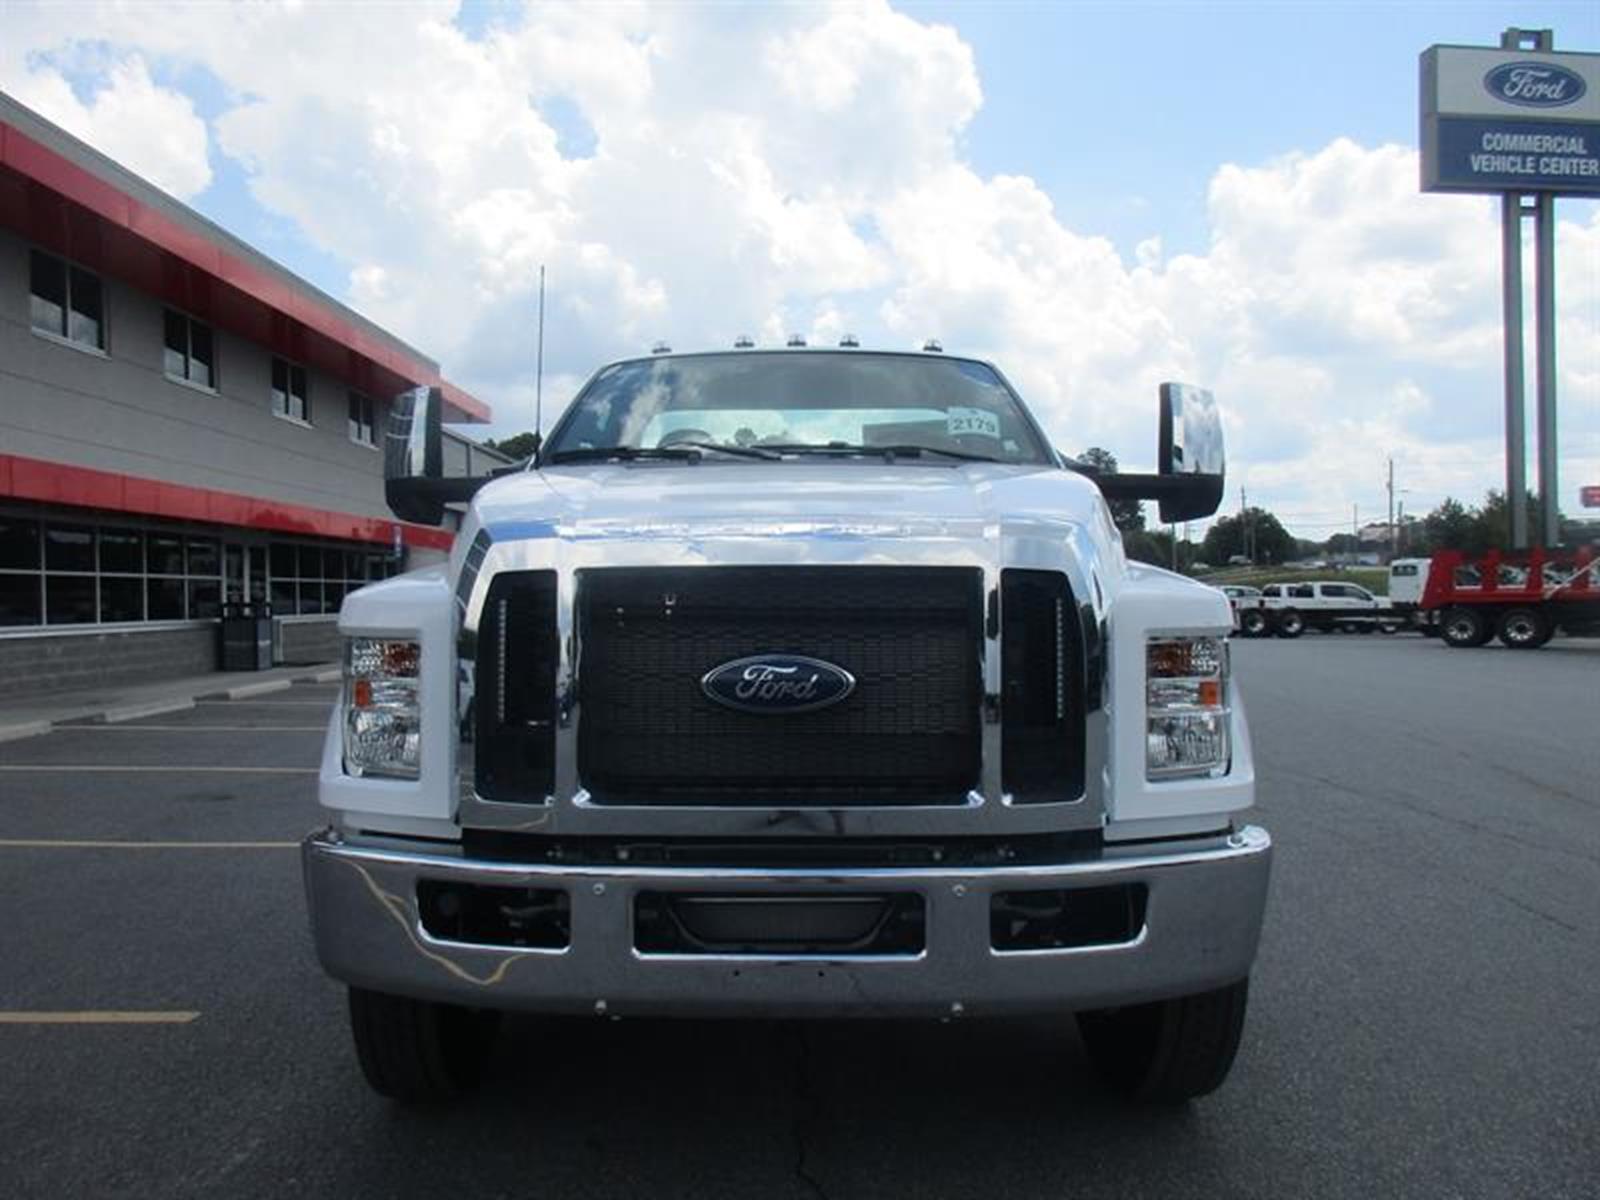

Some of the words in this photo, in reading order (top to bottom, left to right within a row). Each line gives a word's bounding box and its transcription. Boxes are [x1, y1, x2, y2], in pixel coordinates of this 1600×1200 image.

[1503, 69, 1566, 99] Ford
[1482, 133, 1587, 154] COMMERCIAL
[1471, 155, 1536, 173] VEHICLE
[1539, 157, 1599, 176] CENTER
[736, 664, 818, 699] Ford
